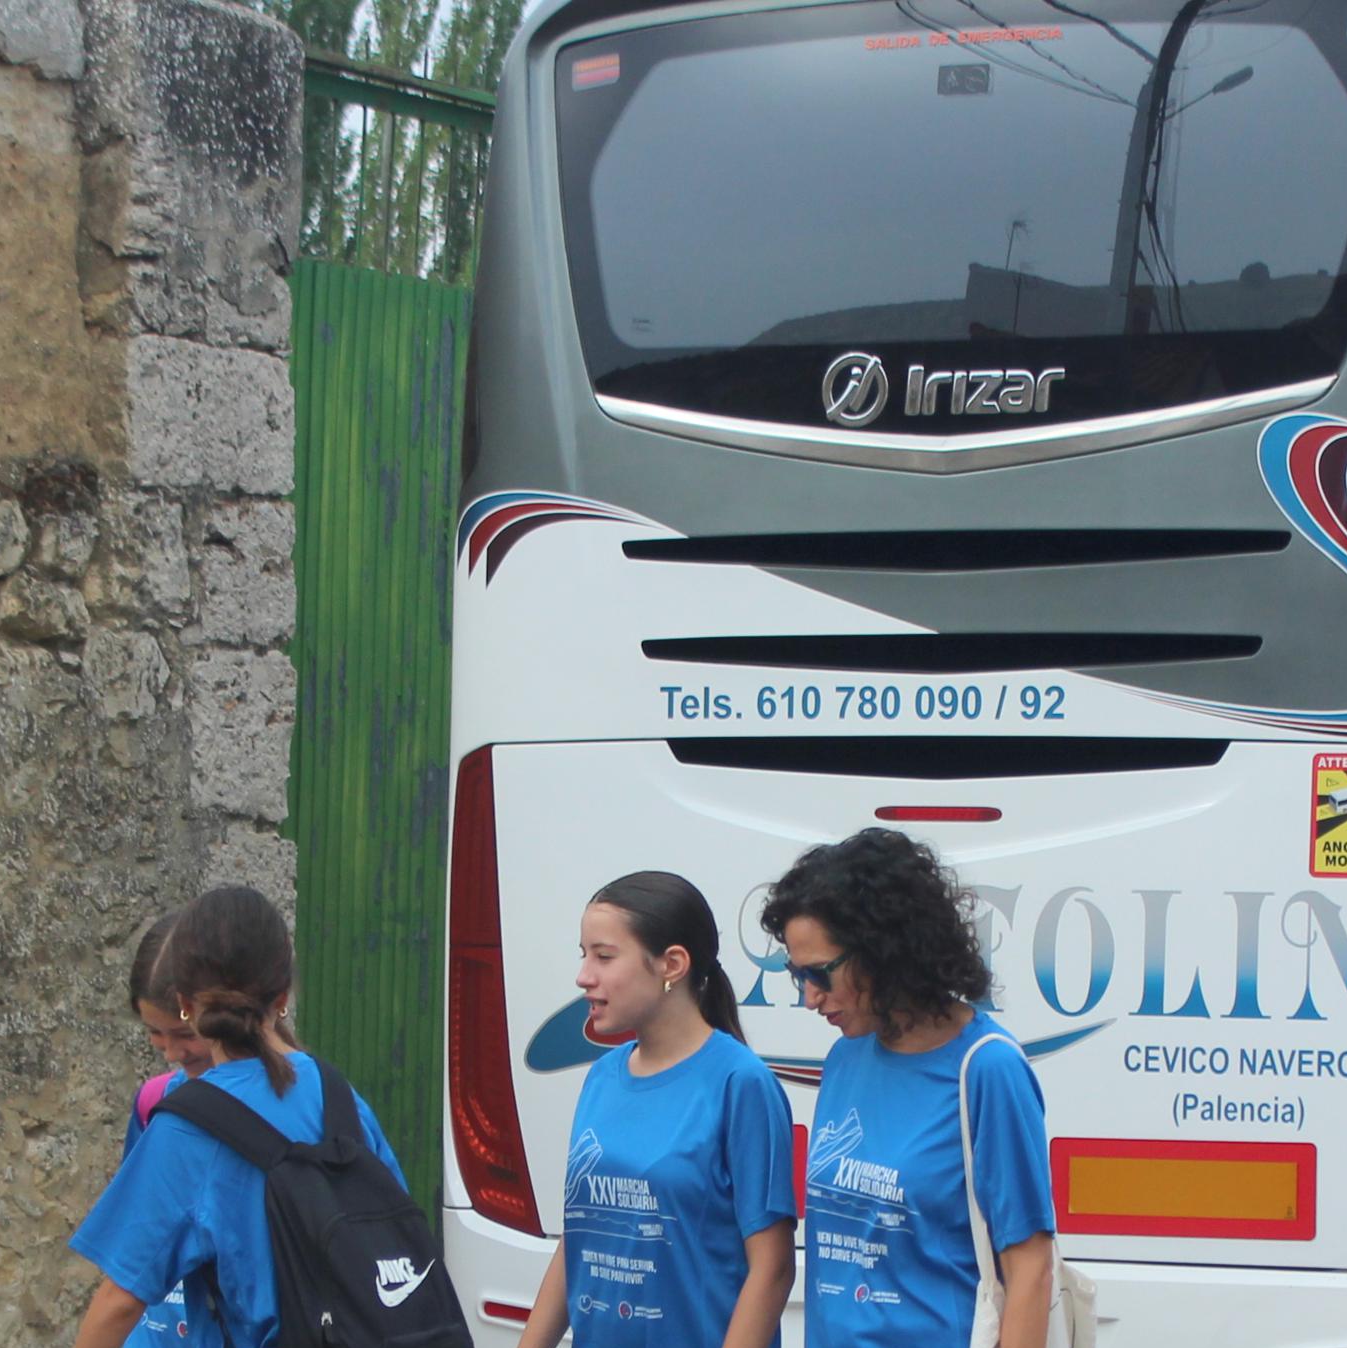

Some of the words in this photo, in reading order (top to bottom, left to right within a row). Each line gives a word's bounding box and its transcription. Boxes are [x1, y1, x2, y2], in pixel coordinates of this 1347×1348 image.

[864, 36, 920, 50] SALIDA
[928, 32, 949, 46] DE
[958, 25, 1064, 44] EMERGENCIA
[660, 686, 743, 719] Tels.
[756, 685, 821, 720] 610
[834, 685, 901, 720] 780
[914, 685, 982, 720] 090
[995, 685, 1007, 720] /
[1019, 685, 1065, 720] 92
[1123, 1045, 1229, 1075] CEVICO
[1172, 1092, 1305, 1131] (Palencia)
[833, 1155, 863, 1191] XXV
[860, 1162, 899, 1186] MARCHA
[586, 1175, 616, 1206] XXV
[616, 1178, 650, 1196] MARCHA
[617, 1193, 659, 1211] SOLIDARIA
[376, 1257, 416, 1287] NIKE
